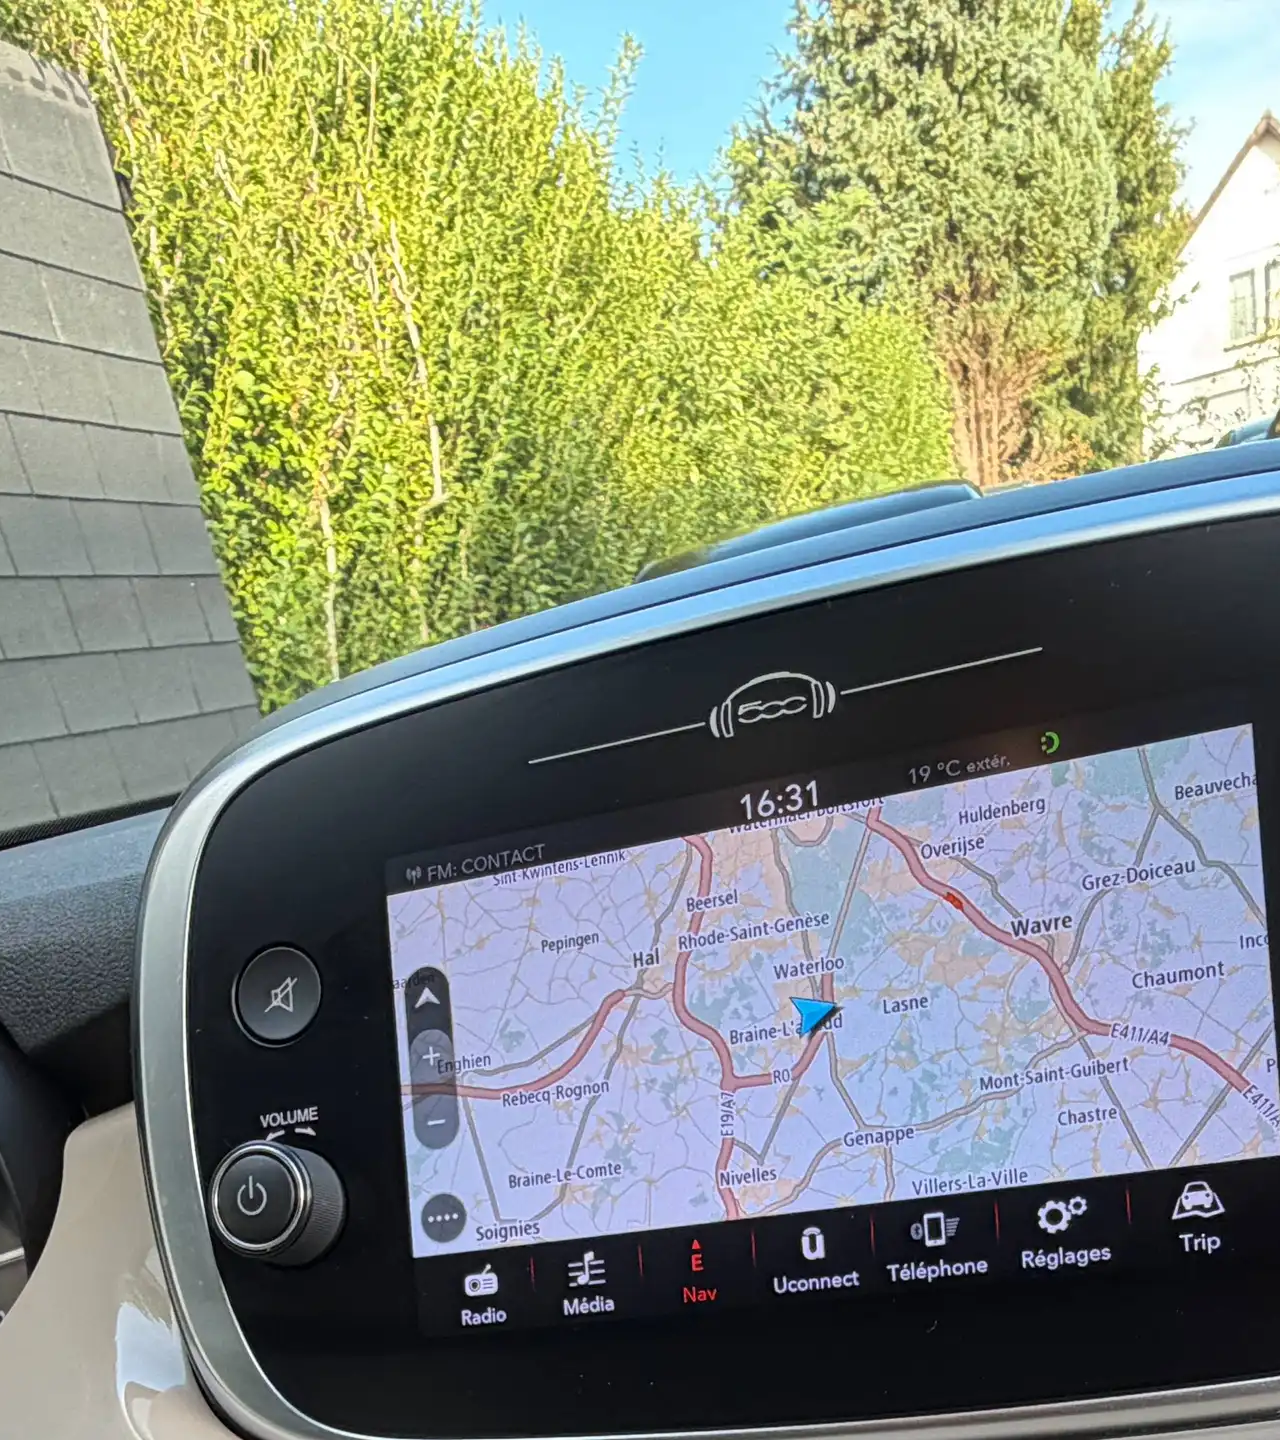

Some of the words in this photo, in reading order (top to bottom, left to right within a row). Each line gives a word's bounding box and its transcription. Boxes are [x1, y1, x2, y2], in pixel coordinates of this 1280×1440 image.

[908, 765, 930, 784] 19
[740, 780, 818, 820] 16:31
[959, 798, 1045, 825] Huldenberg
[921, 835, 985, 859] Overijse
[427, 862, 457, 881] FM:
[461, 844, 545, 874] CONTACT
[1082, 860, 1196, 892] Grez-Doiceau
[686, 890, 738, 912] Beersel
[678, 911, 830, 951] Rhode-Saint-Genèse
[1010, 913, 1072, 937] Wavre
[541, 933, 599, 954] Pepingen
[633, 949, 660, 968] Hal
[773, 955, 844, 979] Waterloo
[1132, 961, 1225, 990] Chaumont
[883, 995, 929, 1015] Lasne
[1111, 1023, 1169, 1045] E411/A4
[437, 1055, 491, 1074] Enghien
[980, 1057, 1129, 1091] Mont-Saint-Guibert
[1266, 1058, 1276, 1072] P
[502, 1081, 609, 1107] Rebecq-Rognon
[260, 1106, 319, 1128] VOLUME
[721, 1091, 734, 1136] E19/A7
[1058, 1107, 1117, 1126] Chastre
[844, 1127, 914, 1148] Genappe
[509, 1161, 621, 1189] Braine-Le-Comte
[720, 1167, 777, 1187] Nivelles
[912, 1168, 1028, 1196] Villers-La-Ville
[476, 1222, 540, 1242] Soignies
[1179, 1234, 1221, 1254] Trip
[1021, 1246, 1111, 1270] Réglages
[887, 1259, 988, 1283] Téléphone
[683, 1286, 717, 1303] Nav
[773, 1271, 860, 1295] Uconnect
[461, 1308, 507, 1326] Radio
[563, 1297, 615, 1316] Média
